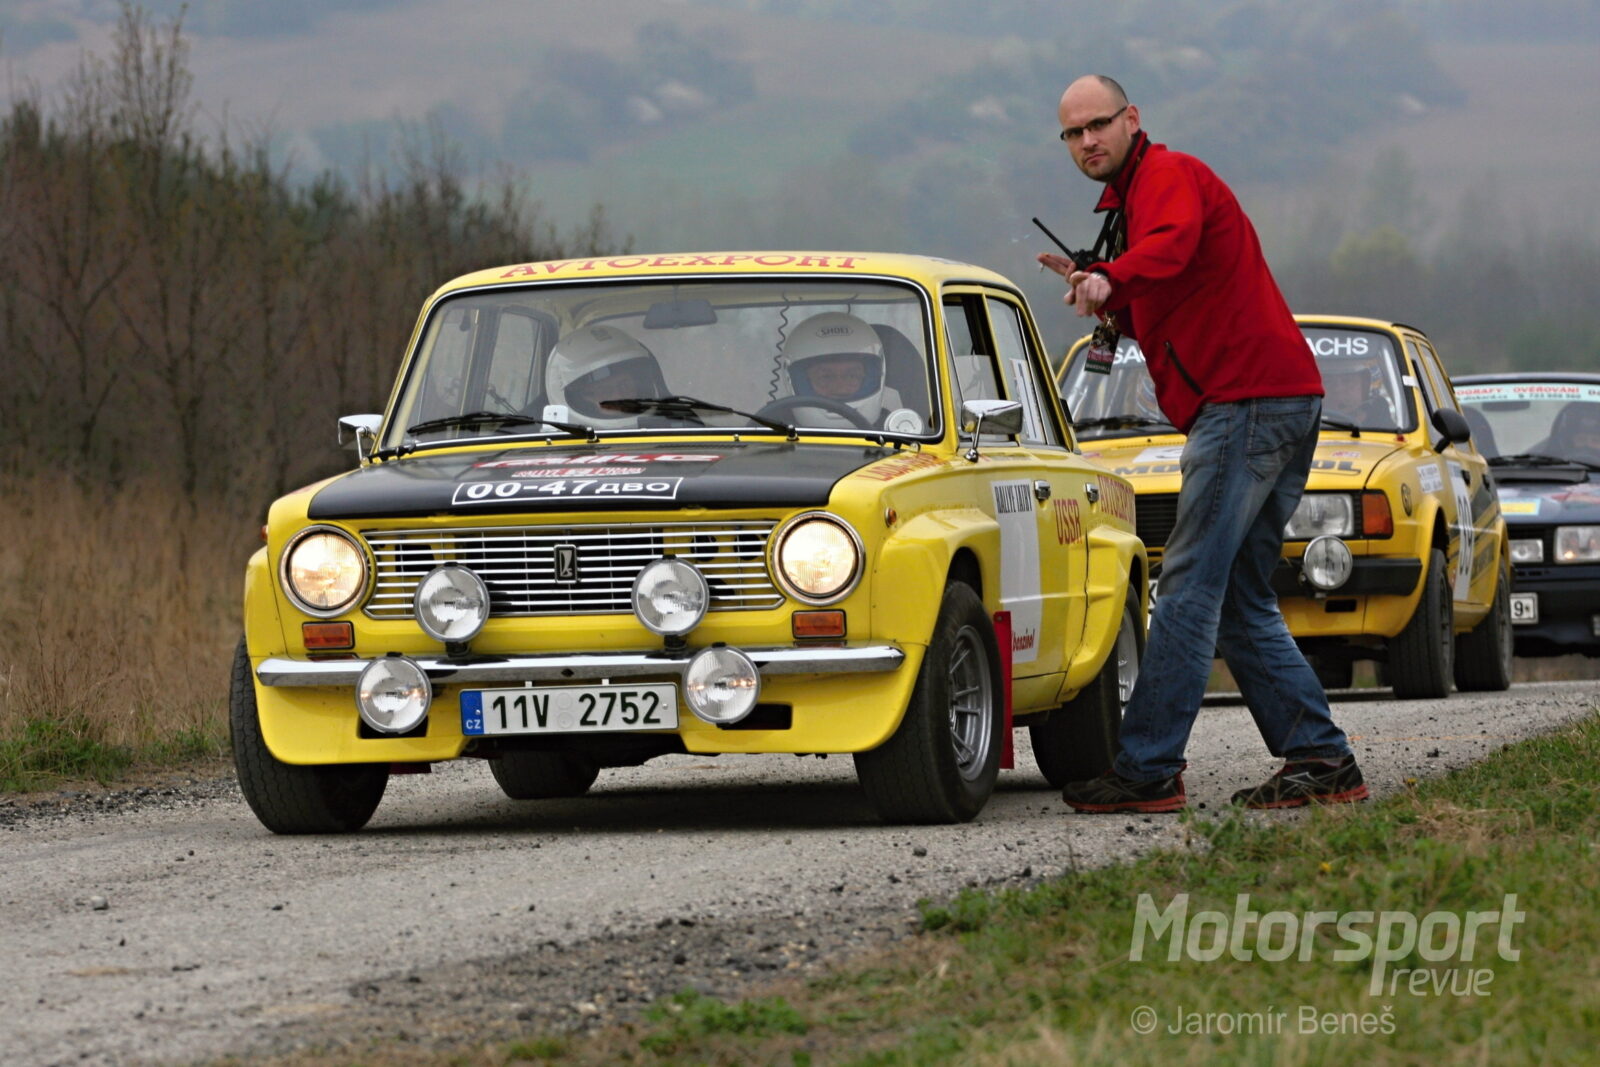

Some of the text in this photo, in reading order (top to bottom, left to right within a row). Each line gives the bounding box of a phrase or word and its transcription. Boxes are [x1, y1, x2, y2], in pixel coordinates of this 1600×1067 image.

[500, 255, 866, 279] AVTOEXPORT
[820, 327, 849, 336] SHOEI
[1113, 345, 1146, 364] SA
[1305, 337, 1369, 356] ACHS
[994, 483, 1033, 514] RALLYE TATRY
[1053, 498, 1082, 545] USSR
[492, 691, 661, 729] 11V 2752
[466, 719, 481, 729] CZ
